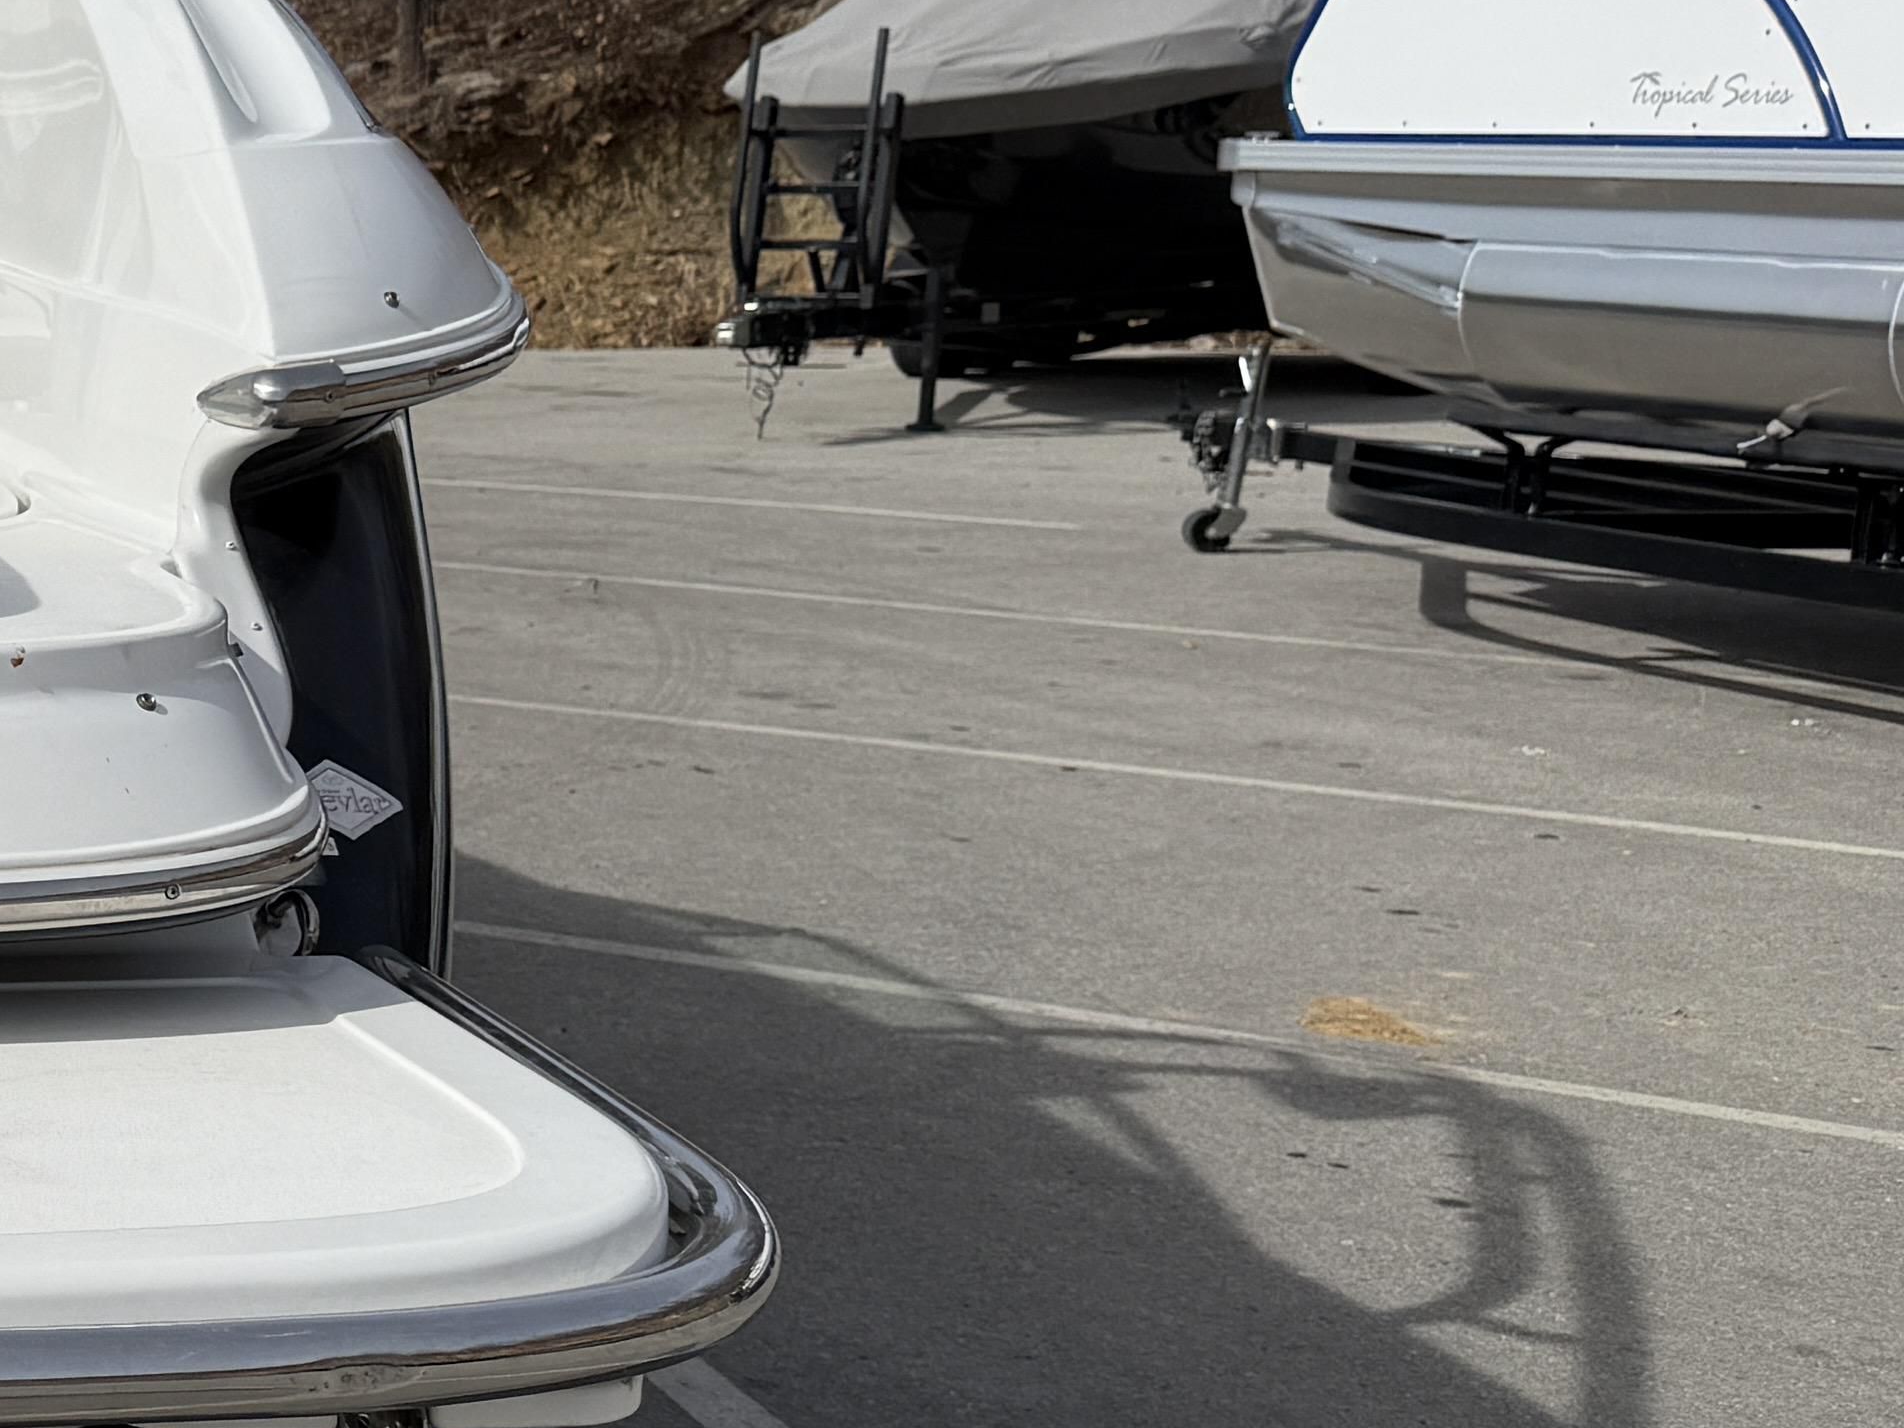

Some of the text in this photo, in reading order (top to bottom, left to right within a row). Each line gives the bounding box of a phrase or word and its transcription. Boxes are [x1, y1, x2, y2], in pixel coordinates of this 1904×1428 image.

[1630, 71, 1794, 118] Tropical Series
[320, 786, 383, 815] evlar
